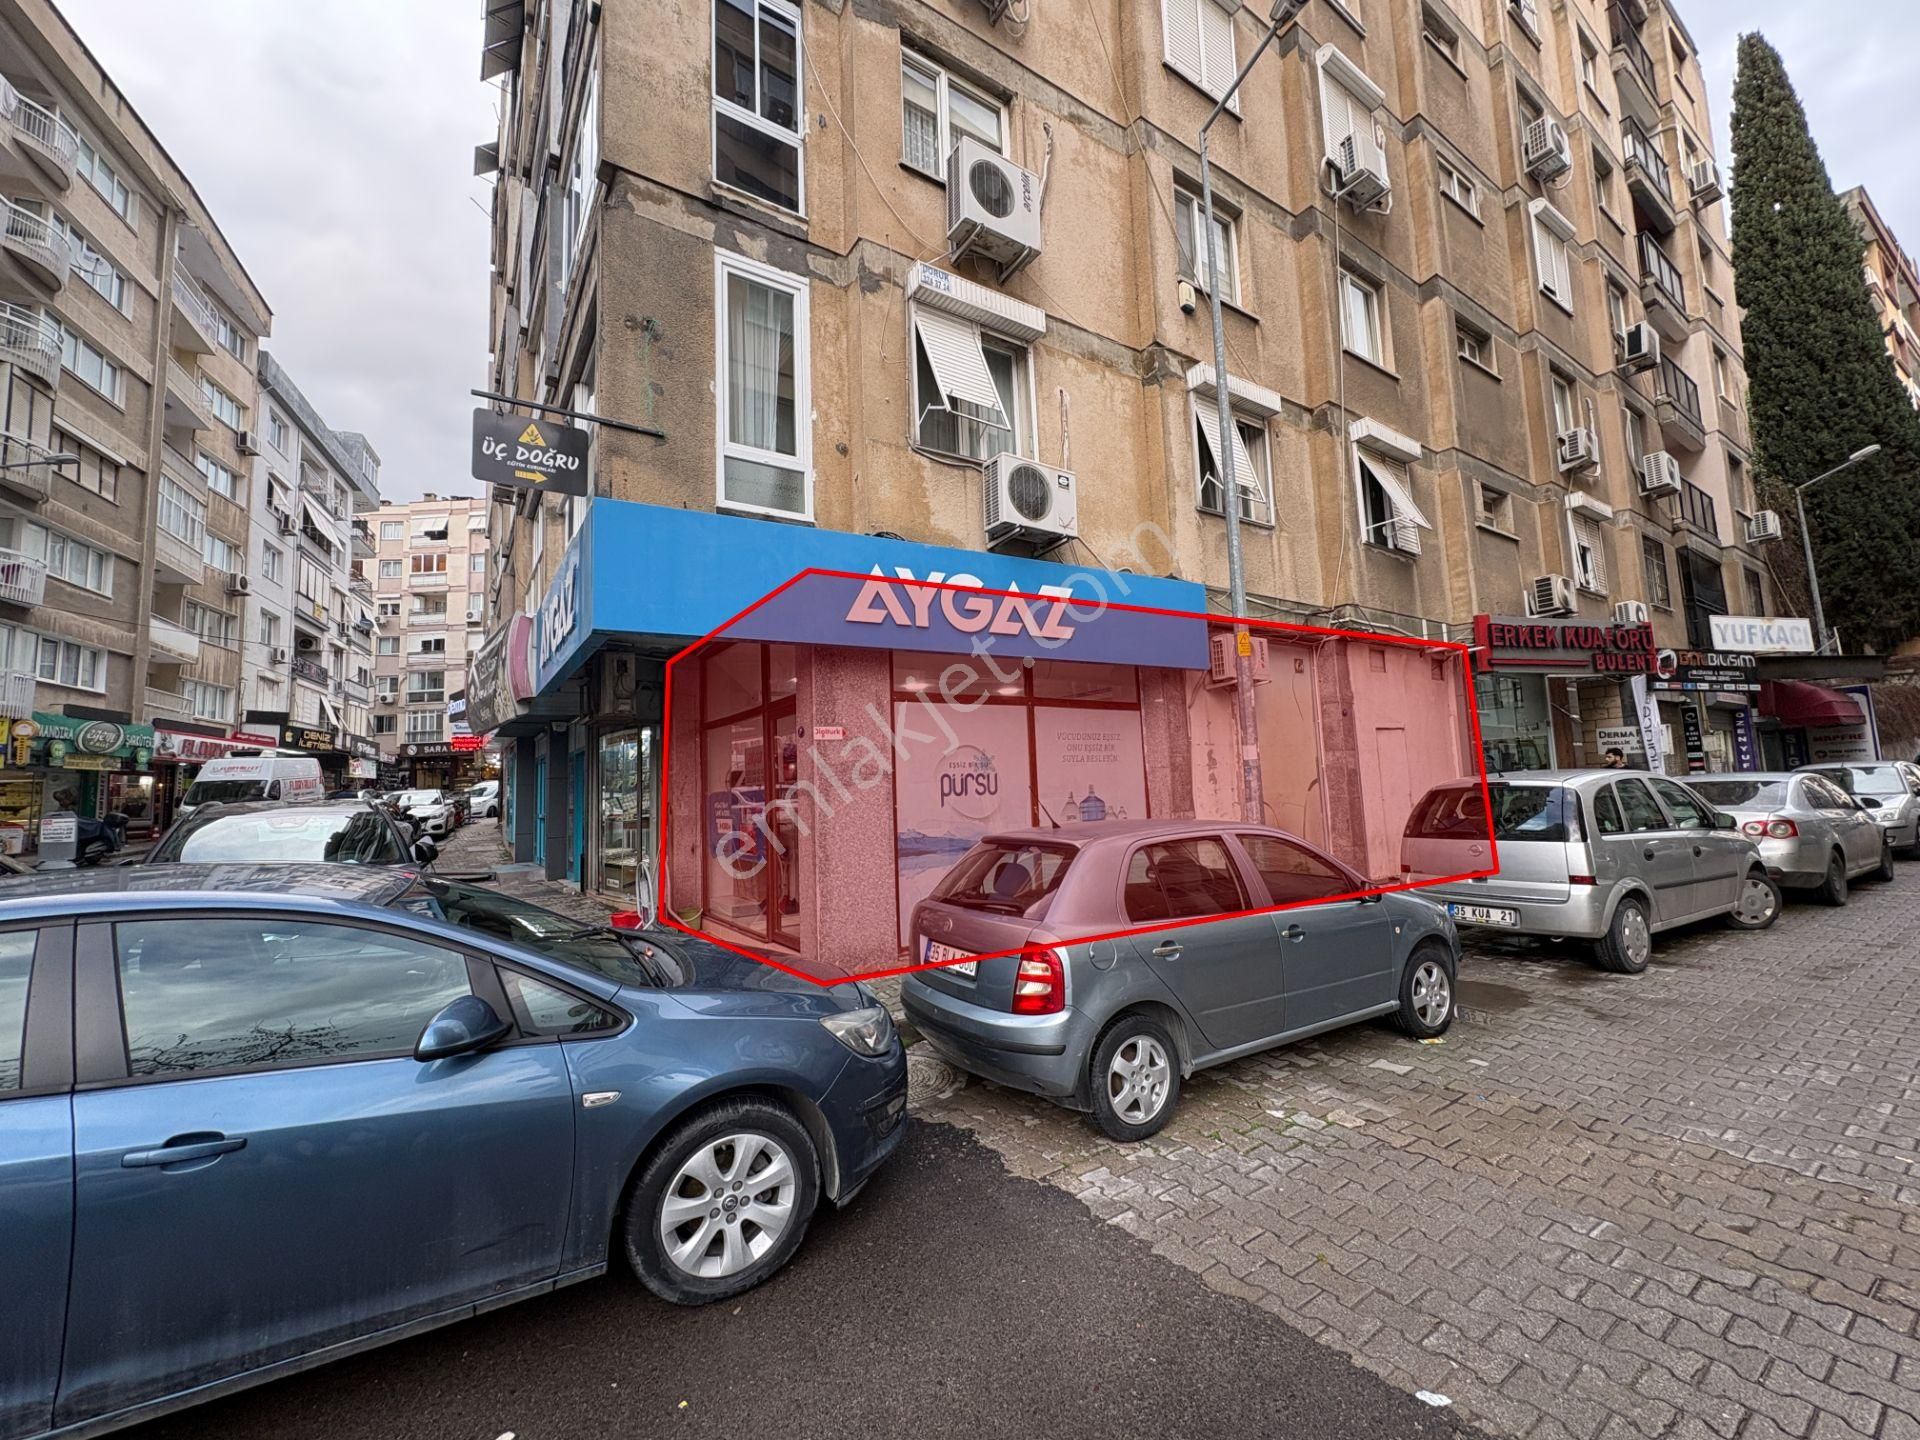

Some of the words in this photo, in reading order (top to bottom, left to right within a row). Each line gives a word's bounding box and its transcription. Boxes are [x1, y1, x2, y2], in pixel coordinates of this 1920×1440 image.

[1020, 171, 1033, 213] arçelik
[482, 436, 508, 460] ÜÇ
[516, 445, 580, 471] DOĞRU
[845, 562, 1077, 640] AYGAZ
[1491, 624, 1559, 648] ERKEK
[1714, 623, 1811, 647] YUFKACI
[1598, 731, 1636, 739] DERMA
[940, 772, 999, 808] pürsu
[1454, 906, 1466, 916] 35
[1471, 907, 1491, 919] KUA
[1500, 910, 1513, 921] 21
[930, 944, 940, 961] 35
